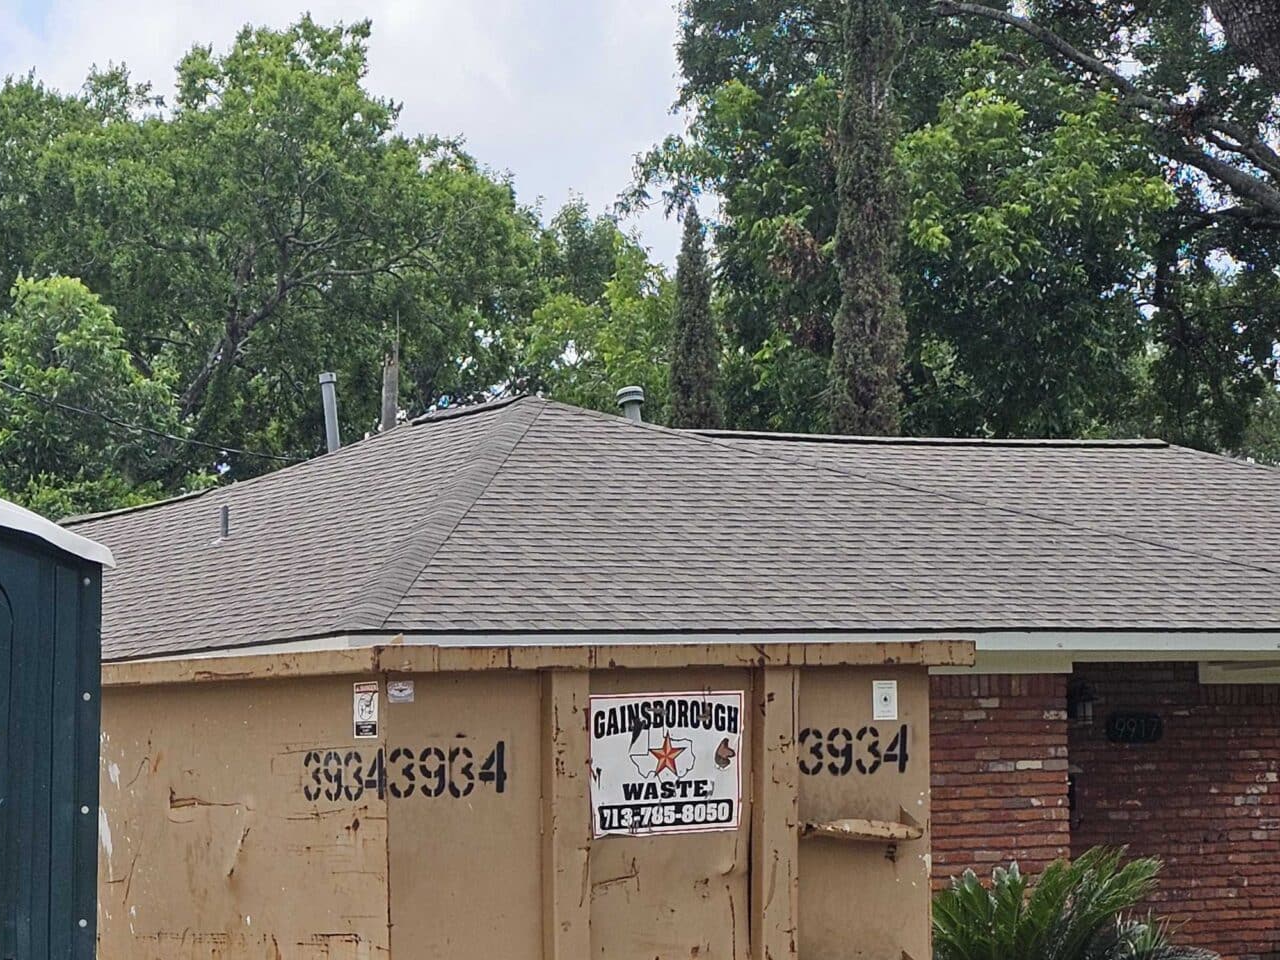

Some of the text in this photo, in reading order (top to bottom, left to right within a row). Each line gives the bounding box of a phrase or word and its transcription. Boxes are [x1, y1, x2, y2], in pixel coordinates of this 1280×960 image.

[594, 699, 739, 739] GAINSBOROUGH
[389, 741, 507, 799] 3934
[799, 724, 908, 776] 3934
[304, 748, 386, 801] 3934
[623, 780, 709, 801] WASTE
[602, 802, 731, 829] 713-785-8050
